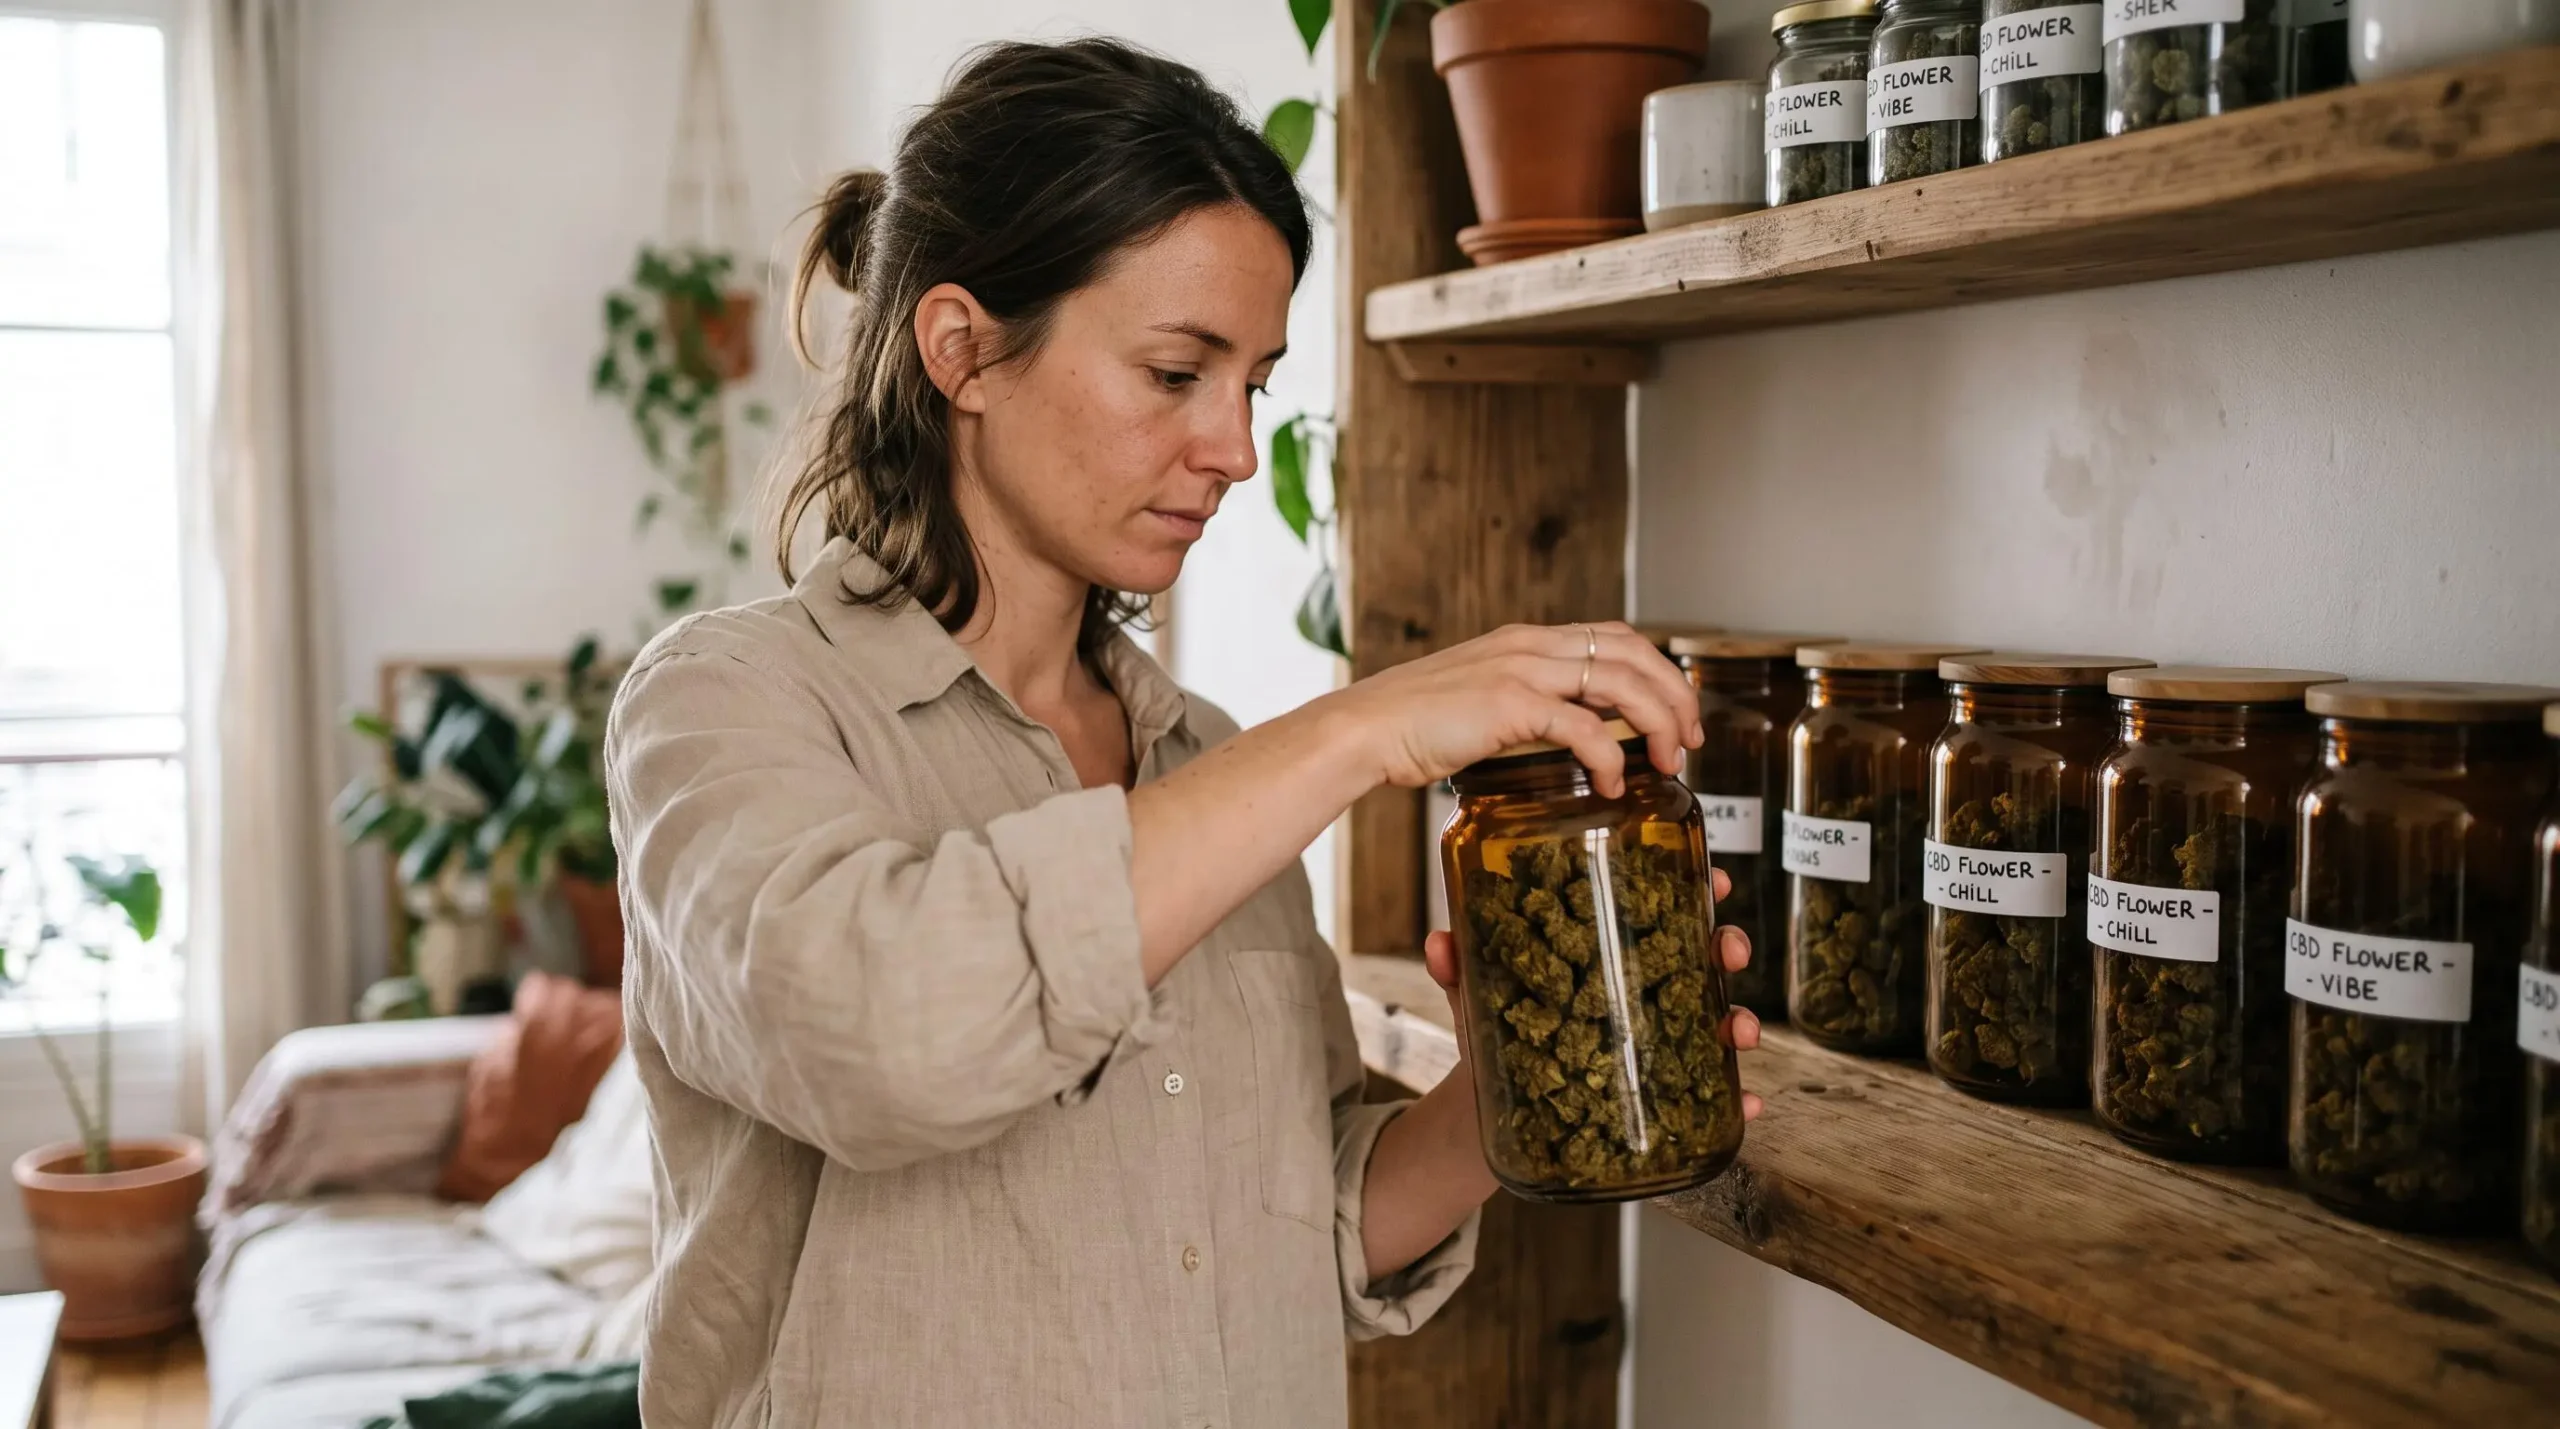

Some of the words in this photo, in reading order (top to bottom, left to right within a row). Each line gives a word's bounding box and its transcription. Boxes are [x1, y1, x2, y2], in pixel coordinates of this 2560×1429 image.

[1998, 16, 2075, 46] FLOWER
[1883, 65, 1954, 92] FLOWER
[1778, 90, 1843, 112] FLOWER
[1926, 851, 1950, 872] CBD
[1958, 856, 2034, 879] FLOWER
[2089, 883, 2109, 908] CBD
[2117, 892, 2195, 919] FLOWER
[2290, 931, 2320, 959] CBD
[2333, 942, 2432, 974] FLOWER
